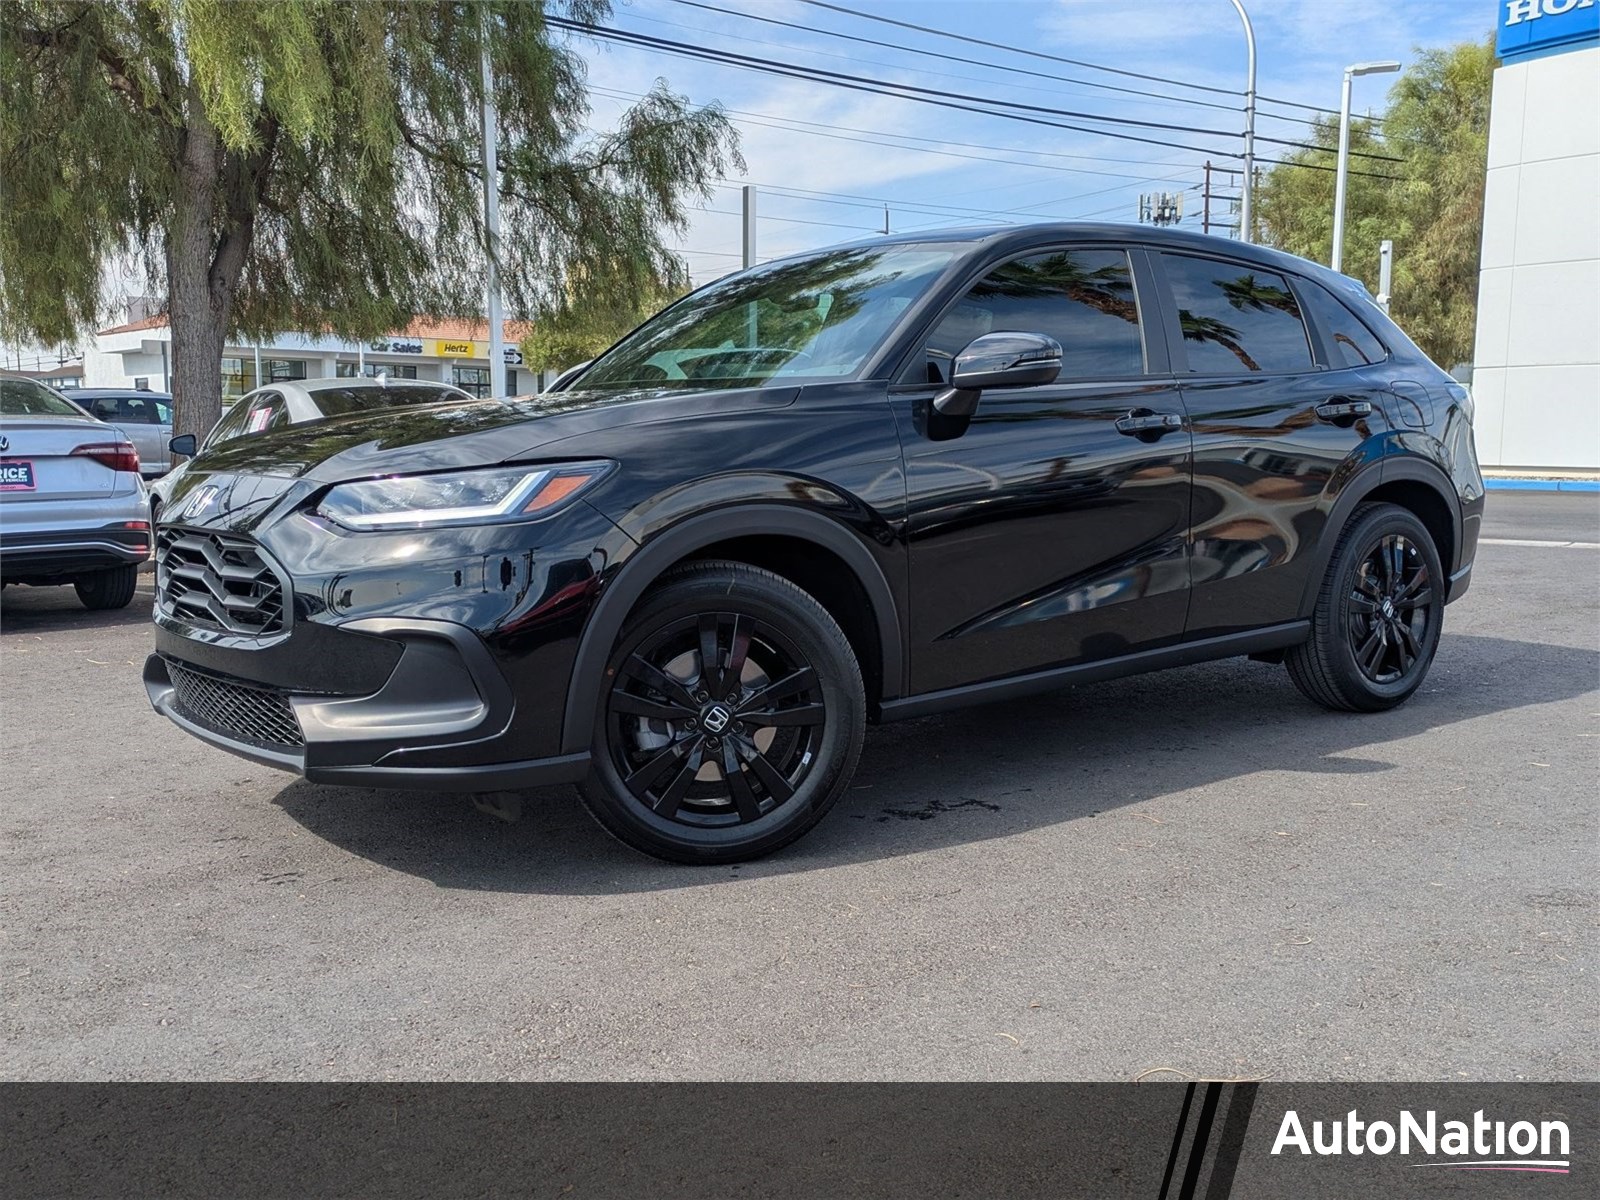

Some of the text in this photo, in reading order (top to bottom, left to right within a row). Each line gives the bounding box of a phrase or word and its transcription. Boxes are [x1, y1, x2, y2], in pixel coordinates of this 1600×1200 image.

[1505, 0, 1594, 26] HO
[370, 342, 423, 353] Car Sales
[444, 343, 468, 353] Hertz
